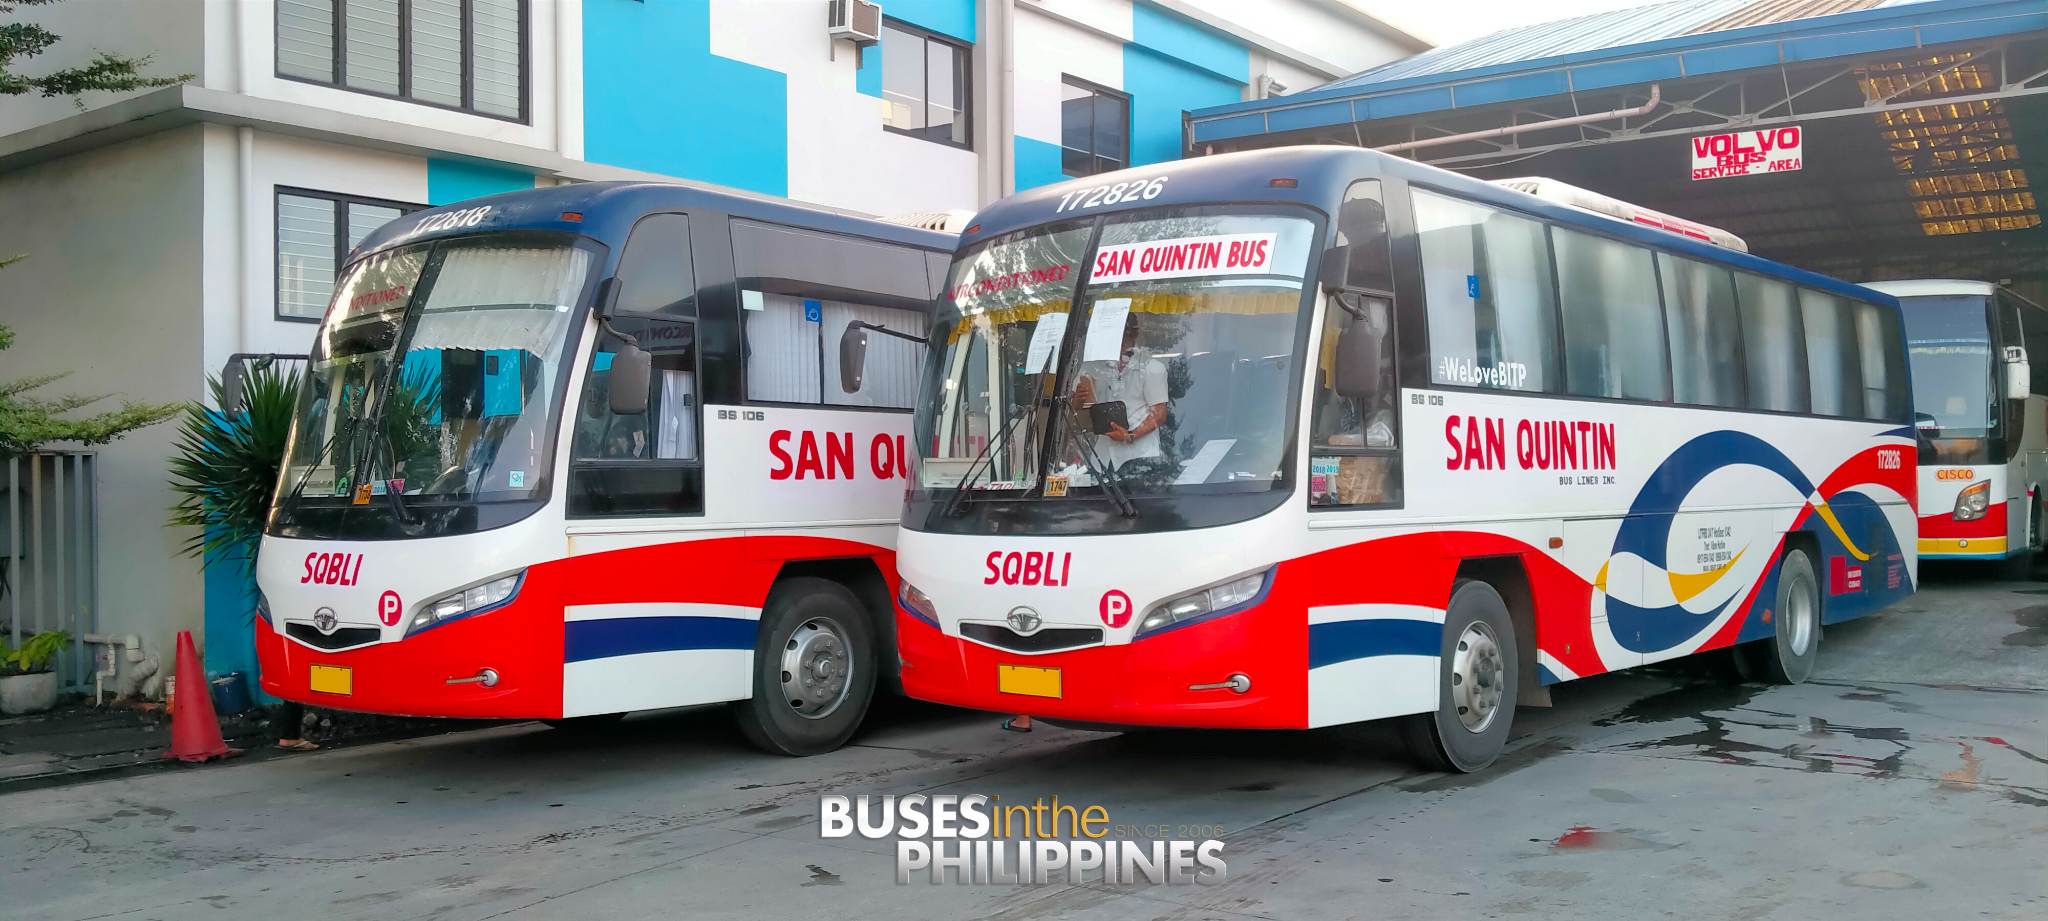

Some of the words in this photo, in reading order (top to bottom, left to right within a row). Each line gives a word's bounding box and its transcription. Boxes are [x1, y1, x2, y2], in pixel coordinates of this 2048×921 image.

[1693, 127, 1800, 158] VOLVO
[1693, 164, 1750, 179] SERVICE
[1768, 158, 1801, 172] AREA
[1716, 151, 1767, 167] BUS
[1056, 176, 1169, 213] 172826
[408, 205, 493, 236] 172818
[1093, 248, 1136, 278] SAN
[1139, 241, 1223, 274] QUINTIN
[1226, 239, 1269, 269] BUS
[1439, 356, 1527, 387] #WeLoveBITP
[1411, 394, 1425, 404] BS
[1428, 395, 1444, 405] 106
[717, 410, 737, 421] BS
[742, 411, 765, 421] 106
[769, 429, 855, 480] SAN
[1445, 415, 1506, 470] SAN
[1516, 419, 1616, 470] QUINTIN
[1877, 449, 1901, 470] 172826
[1937, 469, 1974, 480] CISCO
[1050, 480, 1067, 492] 1747
[1559, 476, 1573, 486] BUS
[1577, 475, 1599, 486] LINES
[300, 552, 364, 587] SQBLI
[984, 550, 1072, 587] SQBLI
[383, 595, 399, 623] P
[1107, 594, 1127, 625] P
